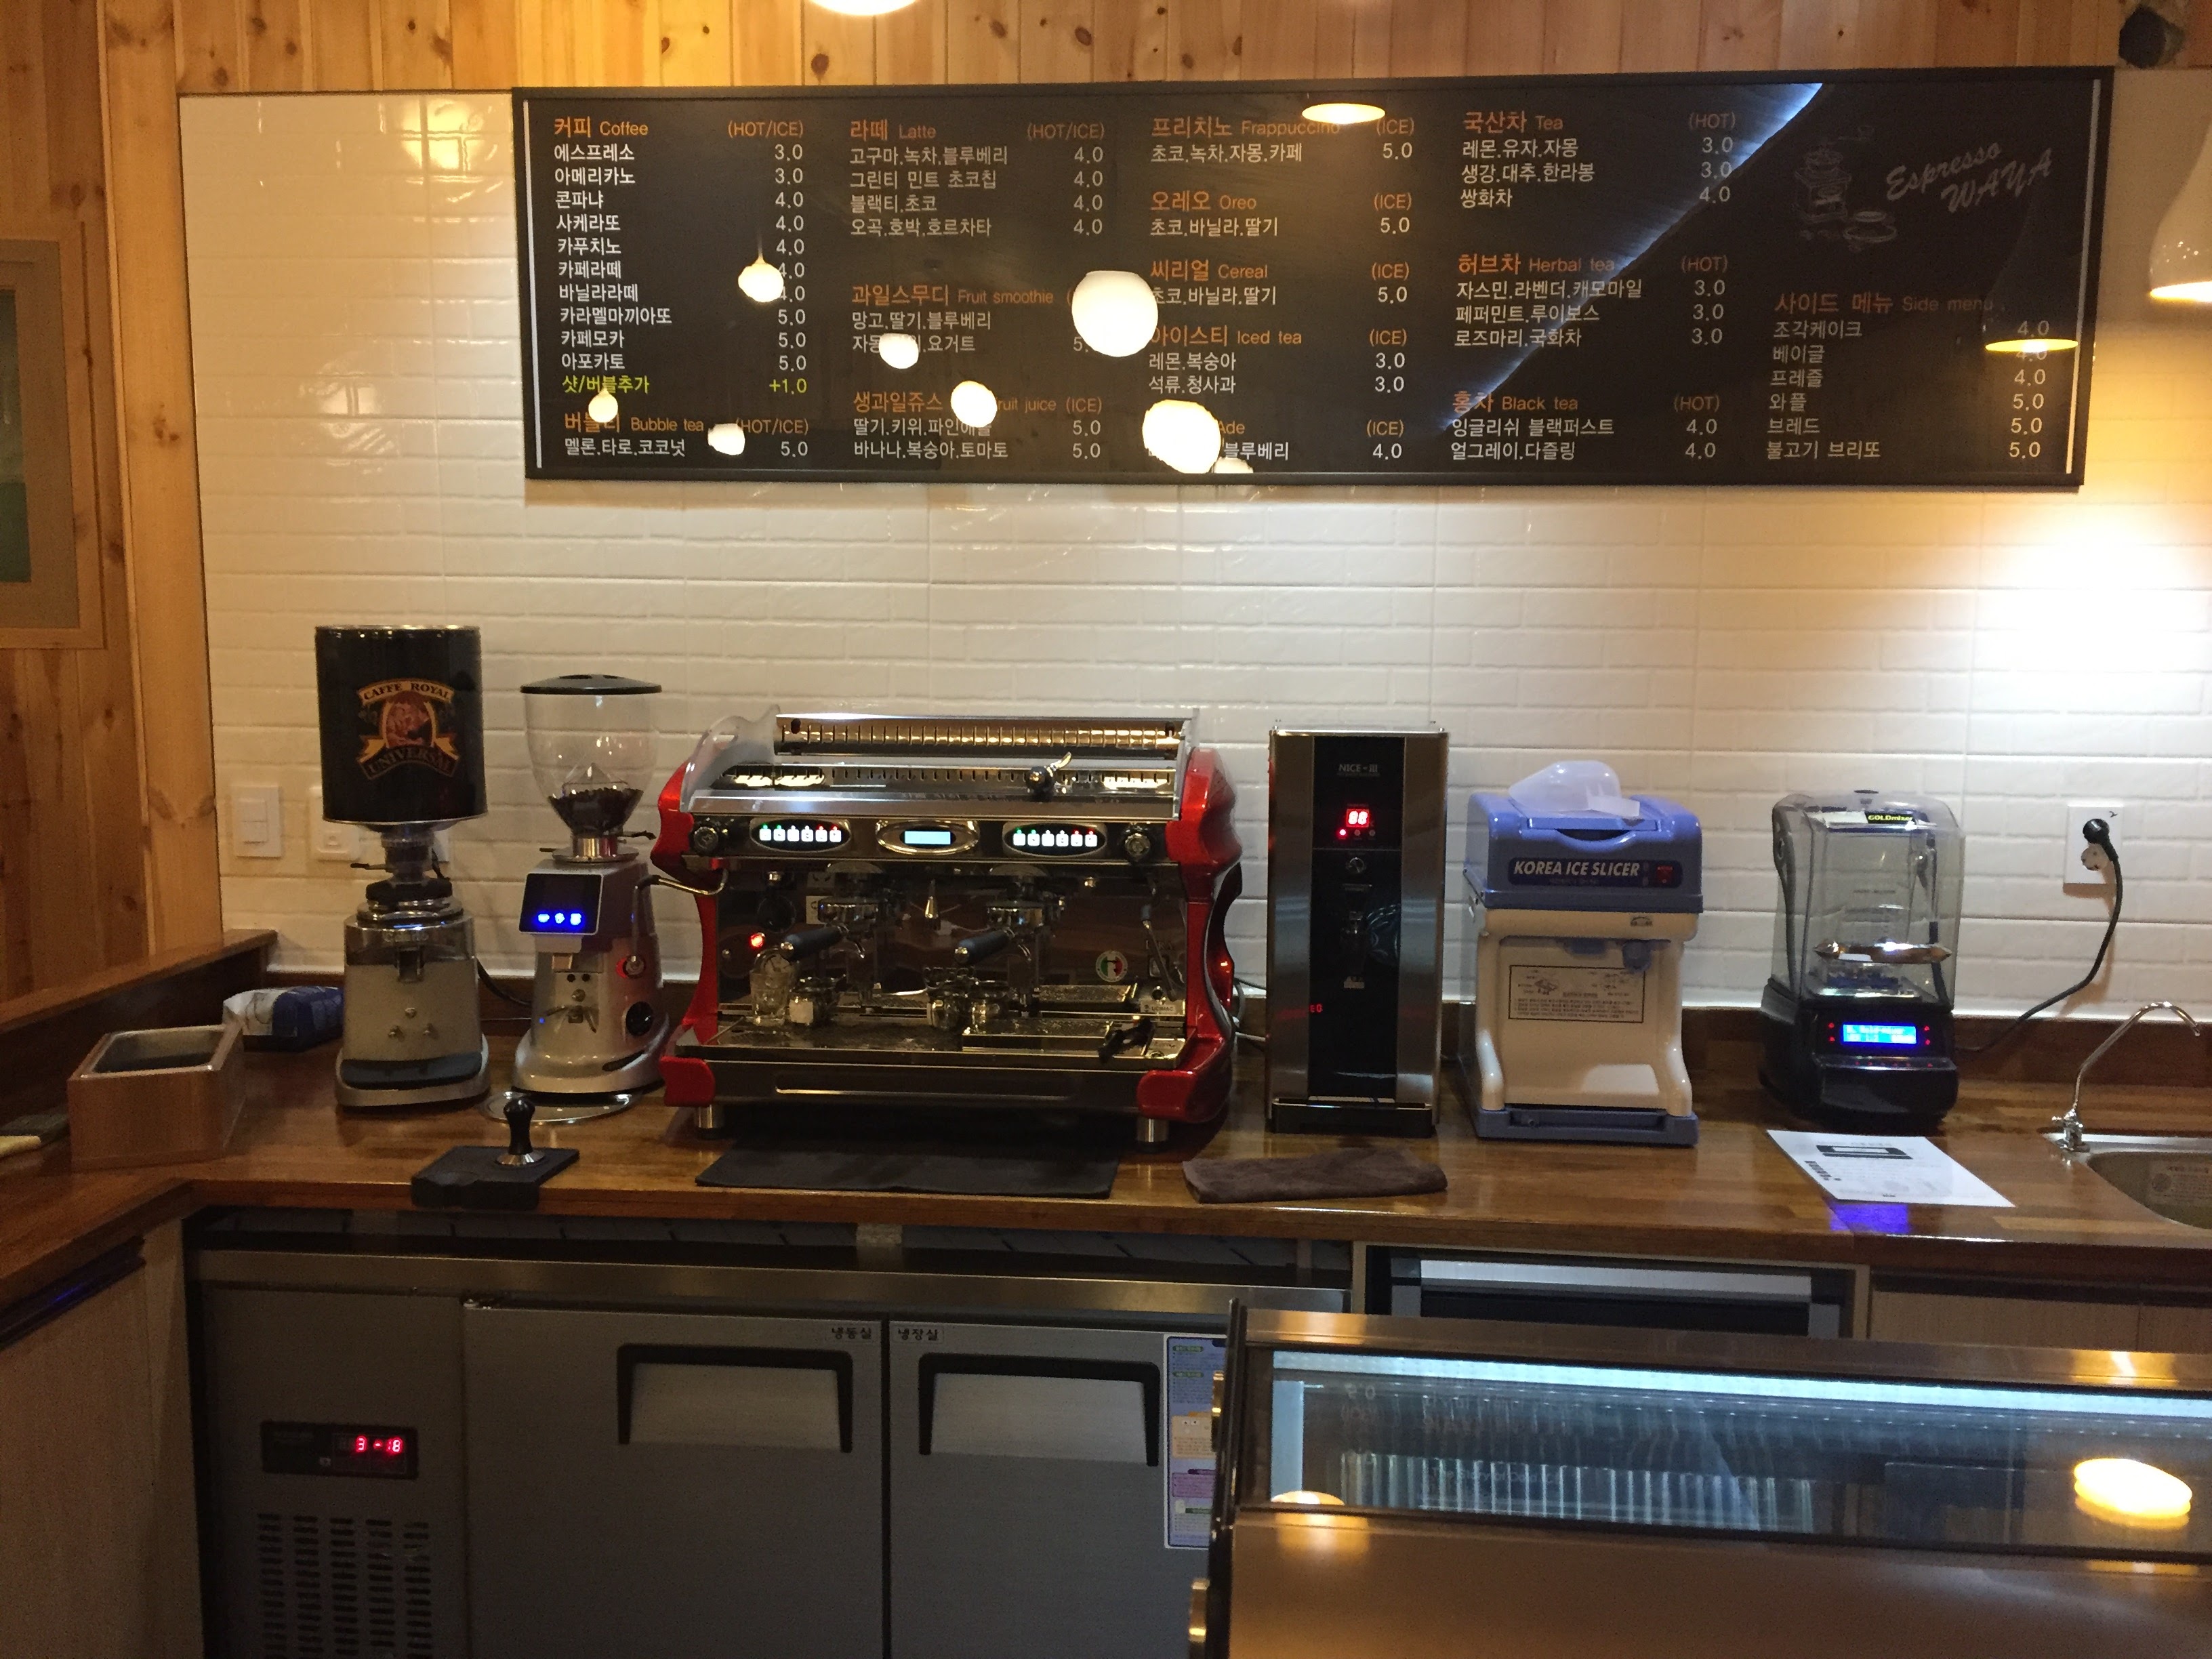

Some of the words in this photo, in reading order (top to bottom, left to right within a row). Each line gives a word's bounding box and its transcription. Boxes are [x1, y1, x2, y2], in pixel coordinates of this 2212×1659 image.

[554, 118, 592, 138] 커피
[600, 121, 649, 136] Coffee
[728, 121, 804, 138] (HOT/ICE)
[851, 120, 887, 142] 라떼
[899, 124, 936, 139] Latte
[1027, 123, 1105, 141] (HOT/ICE)
[1151, 117, 1232, 139] 프리치노
[1242, 120, 1340, 137] Frappuccino
[1376, 117, 1414, 136] (ICE)
[1463, 111, 1527, 134] 국산차
[1536, 115, 1563, 130] Tea
[1689, 113, 1736, 131] (HOT)
[554, 144, 634, 161] 에스프레소
[774, 144, 803, 162] 3.0
[850, 146, 1008, 166] 고구마.녹차.블루베리
[1074, 146, 1103, 164] 4.0
[1151, 143, 1303, 163] 초코.녹차.자몽.카페
[1382, 142, 1413, 160] 5.0
[1462, 138, 1578, 159] 레몬.유자.자몽
[1702, 137, 1734, 154] 3.0
[554, 167, 636, 185] 아메리카노
[775, 168, 803, 186] 3.0
[851, 171, 898, 190] 그린티
[907, 171, 940, 189] 민트
[948, 171, 996, 190] 초코칩
[1073, 171, 1103, 188] 4.0
[1461, 163, 1595, 184] 생강.대추.한라봉
[1701, 162, 1732, 179] 3.0
[1886, 142, 2003, 201] Espresso
[555, 190, 604, 209] 콘파냐
[775, 191, 804, 209] 4.0
[851, 194, 937, 213] 블랙티.초코
[1073, 195, 1103, 212] 4.0
[1151, 191, 1211, 212] 오레오
[1220, 195, 1257, 210] Oreo
[1374, 192, 1412, 211] (ICE)
[1461, 188, 1513, 209] 쌍화차
[1699, 186, 1730, 204] 4.0
[556, 214, 621, 232] 사케라또
[775, 215, 804, 232] 4.0
[851, 219, 991, 237] 오곡.호박.호르차타
[1073, 219, 1103, 237] 4.0
[1151, 218, 1278, 237] 초코.바닐라.딸기
[1380, 217, 1410, 234] 5.0
[558, 237, 621, 255] 카푸치노
[776, 239, 804, 256] 4.0
[558, 261, 621, 279] 카페라떼
[778, 262, 804, 281] 4.0
[1151, 260, 1209, 281] 씨리얼
[1218, 264, 1268, 279] Cereal
[1372, 262, 1410, 281] (ICE)
[1458, 254, 1521, 275] 허브차
[1530, 258, 1582, 272] Herbal
[1591, 258, 1615, 272] tea
[1681, 255, 1727, 273] (HOT)
[559, 284, 638, 302] 바닐라라떼
[852, 285, 949, 306] 과일스무디
[958, 290, 987, 304] Fruit
[994, 289, 1054, 304] smoothie
[1153, 286, 1277, 306] 초코.바닐라.딸기
[1378, 286, 1408, 304] 5.0
[1456, 279, 1642, 300] 자스민.라벤더.캐모마일
[1694, 280, 1725, 298] 3.0
[1774, 292, 1839, 314] 사이드
[1851, 291, 1893, 314] 메뉴
[1902, 295, 1939, 312] Side
[1947, 297, 1994, 312] menu
[560, 307, 672, 325] 카라멜마끼아또
[778, 308, 806, 326] 5.0
[853, 312, 991, 331] 망고.딸기.블루베리
[1456, 304, 1599, 325] 페퍼민트.루이보스
[1693, 304, 1724, 321] 3.0
[561, 331, 625, 348] 카페모카
[779, 331, 806, 349] 5.0
[1151, 325, 1228, 346] 아이스티
[1237, 331, 1270, 345] Iced
[1278, 331, 1302, 345] tea
[1369, 329, 1407, 347] (ICE)
[1454, 328, 1581, 348] 로즈마리.국화차
[1692, 328, 1723, 346] 3.0
[1773, 320, 1863, 340] 조각케이크
[2017, 321, 2050, 338] 4.0
[853, 335, 975, 354] 자몽.요거트
[1773, 344, 1825, 364] 베이글
[562, 353, 625, 371] 아포카토
[779, 355, 806, 372] 5.0
[1149, 352, 1236, 371] 레몬.복숭아
[1376, 352, 1405, 370] 3.0
[562, 376, 650, 394] 샷/버블추가
[769, 378, 807, 394] +1.0
[1149, 375, 1236, 394] 석류.청사과
[1375, 376, 1405, 393] 3.0
[1770, 369, 1824, 388] 프레즐
[2014, 369, 2046, 386] 4.0
[854, 392, 943, 413] 생과일쥬스
[1025, 398, 1057, 414] juice
[1066, 398, 1102, 414] (ICE)
[1453, 391, 1494, 413] 홍차
[1502, 396, 1545, 411] Black
[1555, 397, 1578, 411] tea
[1675, 394, 1719, 413] (HOT)
[1769, 392, 1807, 413] 와플
[2013, 393, 2045, 411] 5.0
[631, 417, 677, 432] Bubble
[683, 419, 704, 432] tea
[735, 417, 808, 435] (HOT/ICE)
[1073, 420, 1101, 436] 5.0
[1218, 421, 1246, 434] Ade
[1367, 419, 1404, 438] (ICE)
[1452, 418, 1519, 438] 잉글리쉬
[1528, 417, 1614, 437] 블랙퍼스트
[1686, 418, 1717, 436] 4.0
[1767, 417, 1820, 434] 브레드
[2011, 417, 2043, 435] 5.0
[565, 438, 685, 457] 멜론.타로.코코넛
[780, 441, 808, 458] 5.0
[854, 441, 1008, 459] 바나나.복숭아.토마토
[1073, 444, 1101, 460] 5.0
[1372, 443, 1402, 459] 4.0
[1451, 442, 1575, 462] 얼그레이.다즐링
[1685, 442, 1716, 460] 4.0
[1767, 441, 1818, 460] 불고기
[1828, 441, 1881, 459] 브리또
[2009, 442, 2041, 459] 5.0
[364, 683, 403, 700] CAFFE
[411, 682, 450, 699] ROYAL
[367, 746, 453, 775] UNIVERSAL
[1514, 861, 1562, 875] KOREA
[1566, 861, 1589, 876] ICE
[1593, 862, 1640, 876] SLICER
[832, 1327, 872, 1340] 냉동실
[898, 1328, 939, 1341] 냉장실
[356, 1436, 367, 1452] 3
